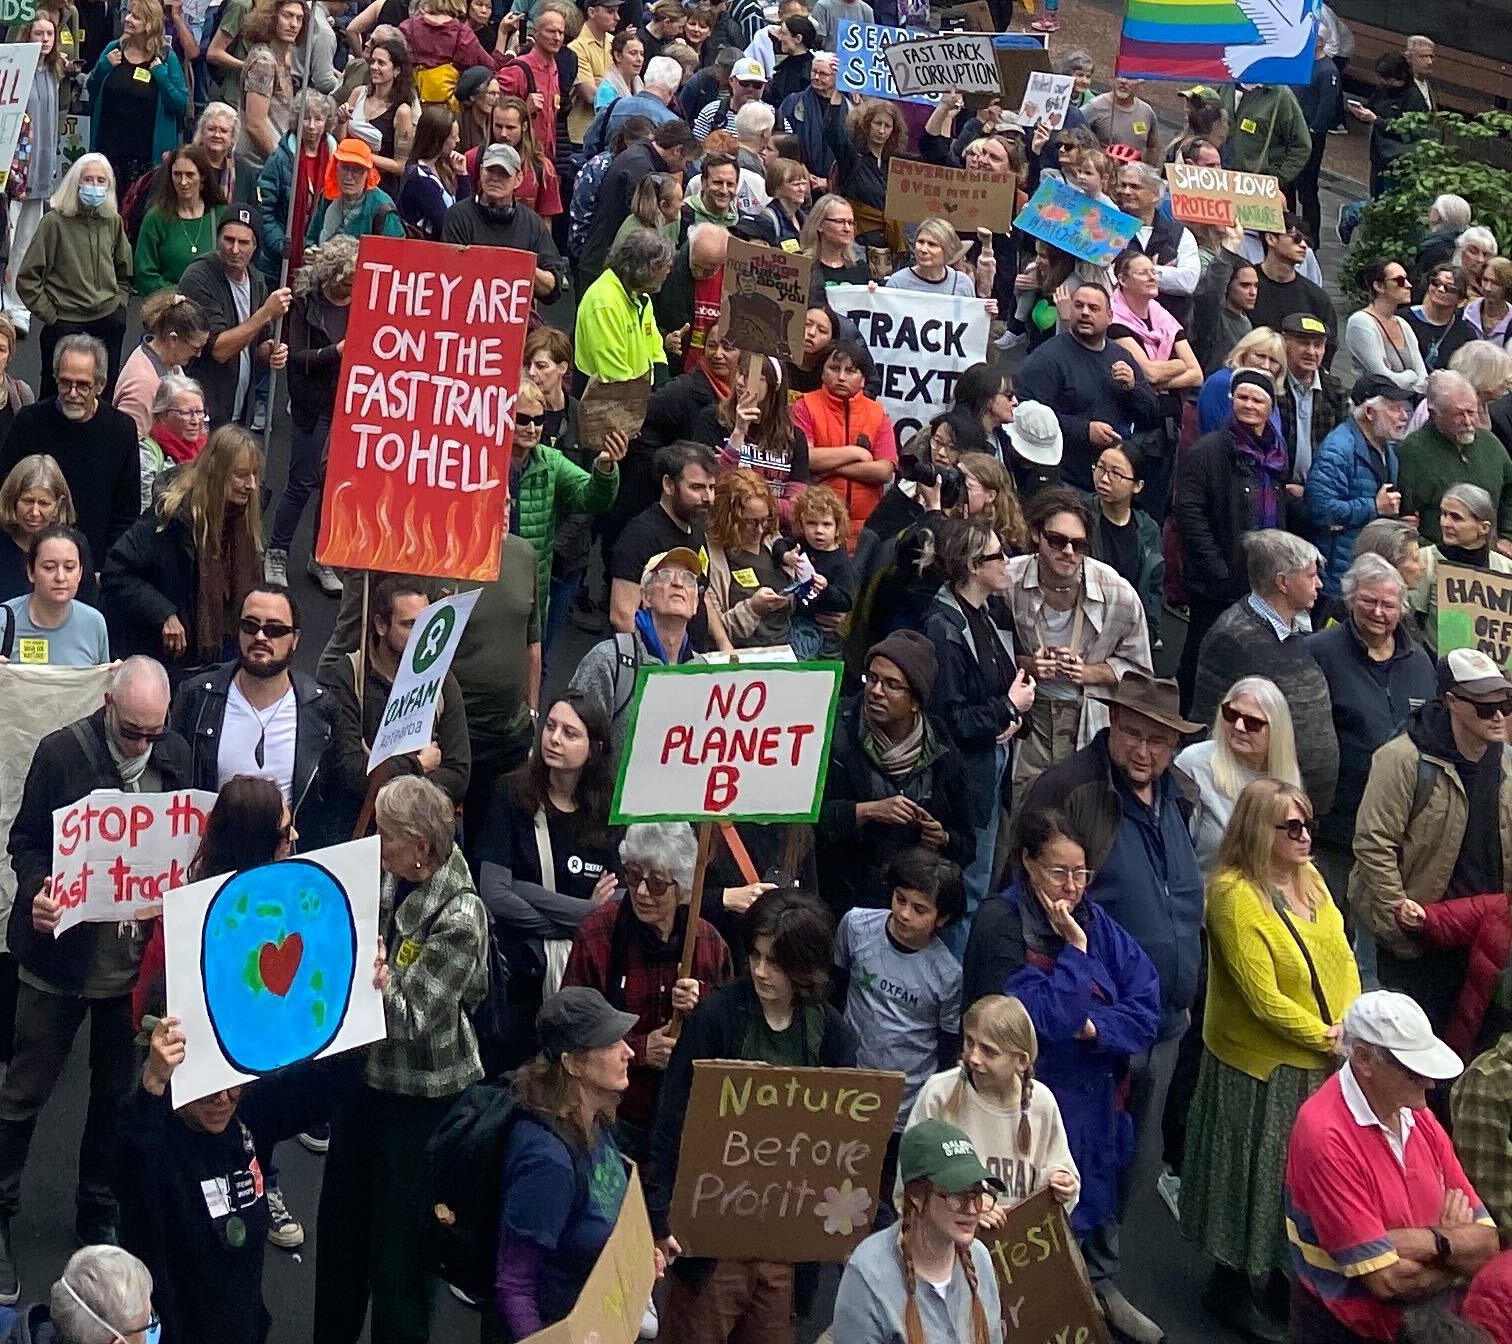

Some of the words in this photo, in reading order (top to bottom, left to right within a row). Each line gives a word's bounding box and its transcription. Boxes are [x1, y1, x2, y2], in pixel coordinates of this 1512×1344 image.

[902, 46, 936, 65] FAST
[937, 43, 984, 62] TRACK
[894, 62, 921, 92] 2
[914, 62, 1000, 87] CORRUPTION
[900, 178, 941, 197] OVER
[1174, 163, 1228, 193] SHOW
[1172, 193, 1232, 220] PROTECT
[1235, 204, 1277, 224] NATURE
[750, 260, 782, 281] hate
[751, 253, 800, 280] things
[756, 275, 802, 294] about
[362, 261, 463, 321] THEY
[465, 277, 531, 325] ARE
[776, 290, 806, 304] you
[372, 324, 426, 362] ON
[433, 330, 503, 377] THE
[845, 309, 970, 359] TRACK
[345, 364, 430, 422] FAST
[430, 374, 517, 447] TRACK
[350, 423, 405, 472] TO
[407, 428, 500, 493] HELL
[1445, 576, 1512, 616] HAN
[383, 676, 441, 728] OXFAM
[704, 680, 767, 723] NO
[660, 723, 815, 767] PLANET
[703, 764, 740, 812] B
[165, 794, 214, 838] th
[878, 978, 919, 1006] OXFAM
[718, 1074, 882, 1123] Nature
[720, 1129, 872, 1176] Before
[691, 1171, 817, 1223] Profit
